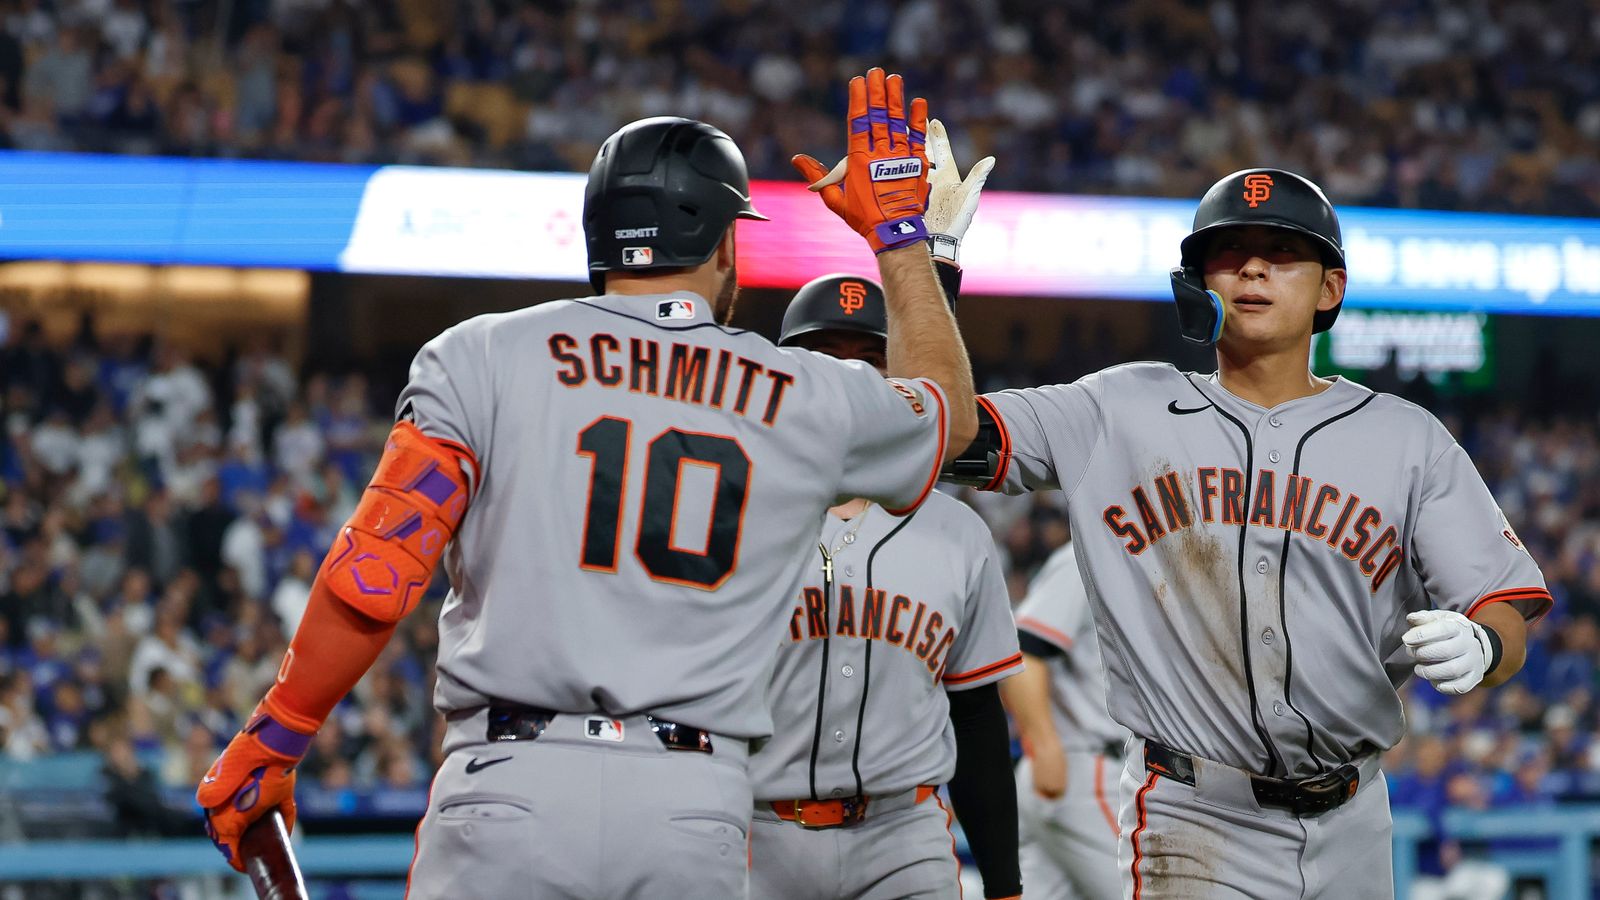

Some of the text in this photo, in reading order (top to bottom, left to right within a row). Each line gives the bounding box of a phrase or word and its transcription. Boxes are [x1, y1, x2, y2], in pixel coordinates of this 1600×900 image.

[874, 162, 920, 179] Franklin
[1243, 174, 1274, 208] SF
[615, 227, 659, 240] SCHMITT
[839, 281, 867, 315] SF
[547, 333, 795, 428] SCHMITT
[575, 414, 753, 592] 10
[1103, 466, 1403, 597] SAN FRANCISCO
